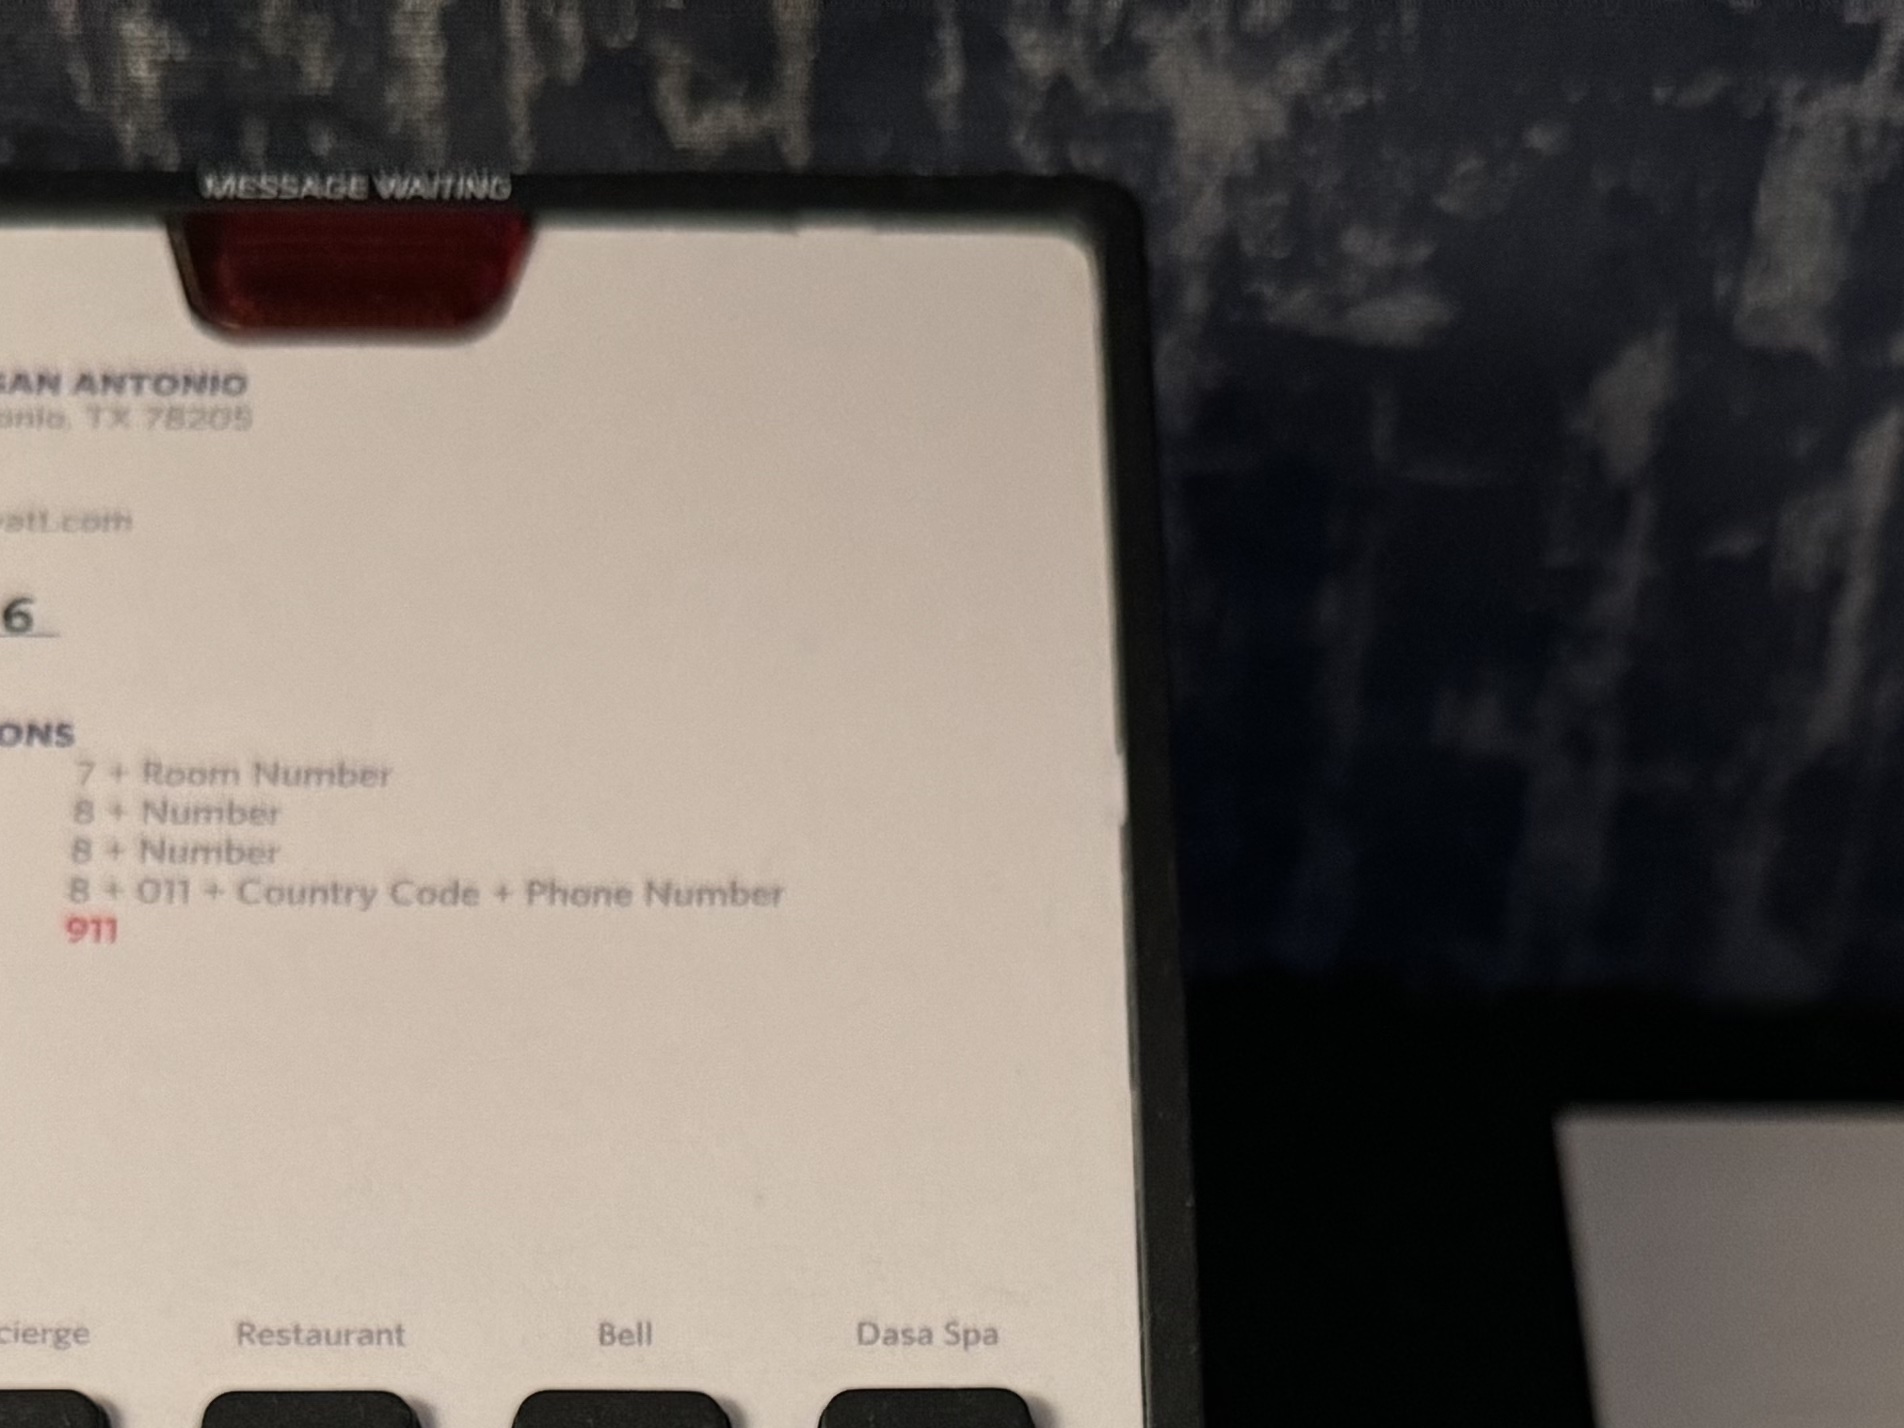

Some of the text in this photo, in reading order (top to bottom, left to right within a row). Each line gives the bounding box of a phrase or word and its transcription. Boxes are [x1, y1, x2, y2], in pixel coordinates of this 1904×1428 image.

[201, 175, 512, 199] MESSAGE WAITING
[74, 374, 248, 396] ANTONIO
[87, 408, 132, 430] TX
[78, 762, 95, 786] 7
[143, 762, 240, 787] Room
[254, 762, 393, 787] Number
[74, 801, 94, 825] 8
[142, 801, 280, 825] Number
[71, 839, 93, 863] 8
[140, 840, 280, 864] Number
[69, 880, 89, 903] 8
[137, 880, 190, 904] 011
[237, 880, 378, 911] Country
[390, 880, 481, 906] Code
[526, 881, 633, 907] Phone
[645, 881, 785, 907] Number
[66, 918, 117, 943] 911
[236, 1322, 406, 1347] Restaurant
[598, 1322, 653, 1347] Bell
[857, 1321, 999, 1350] Dasa Spa
